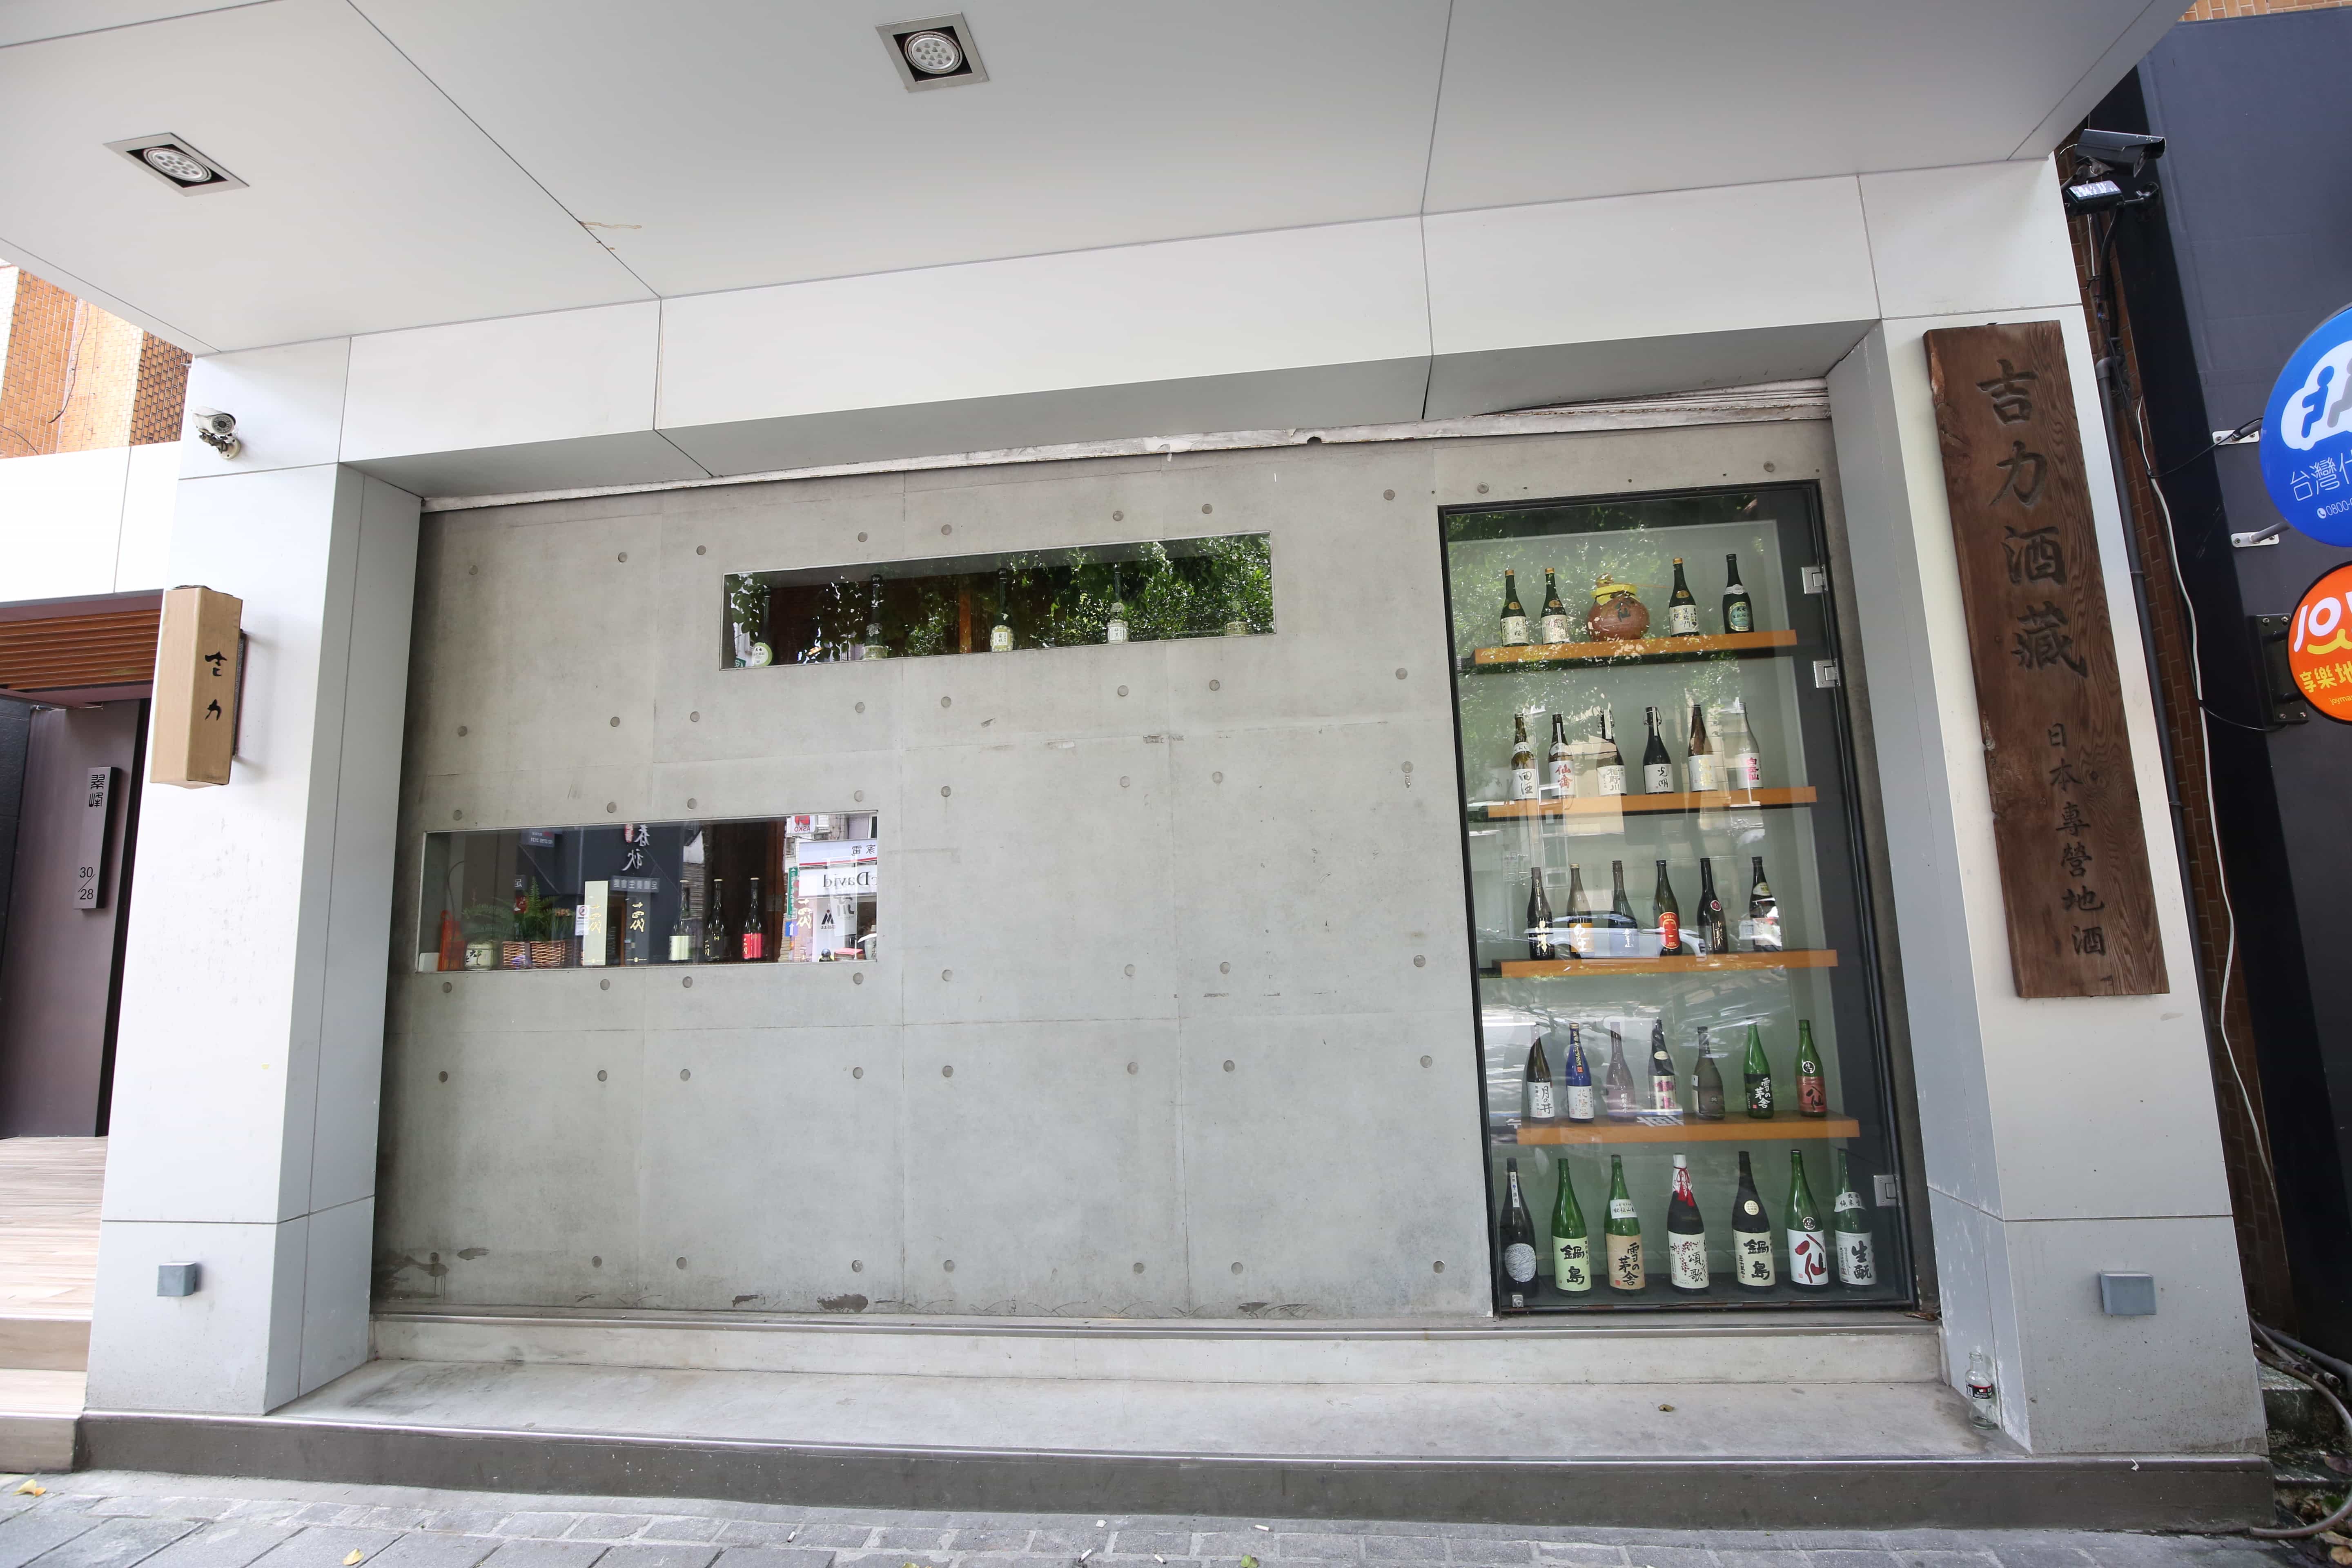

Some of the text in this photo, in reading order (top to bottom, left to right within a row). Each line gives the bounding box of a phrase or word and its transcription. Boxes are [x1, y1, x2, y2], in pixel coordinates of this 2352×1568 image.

[1977, 359, 2089, 678] 吉力酒藏
[2294, 591, 2352, 652] JO
[205, 651, 227, 720] 吉力
[2047, 722, 2107, 957] 日本專營地酒
[79, 867, 94, 878] 30
[80, 889, 94, 900] 28
[1540, 1085, 1552, 1114] 月の井
[1560, 1245, 1585, 1285] 鍋島
[1744, 1239, 1770, 1280] 鍋島
